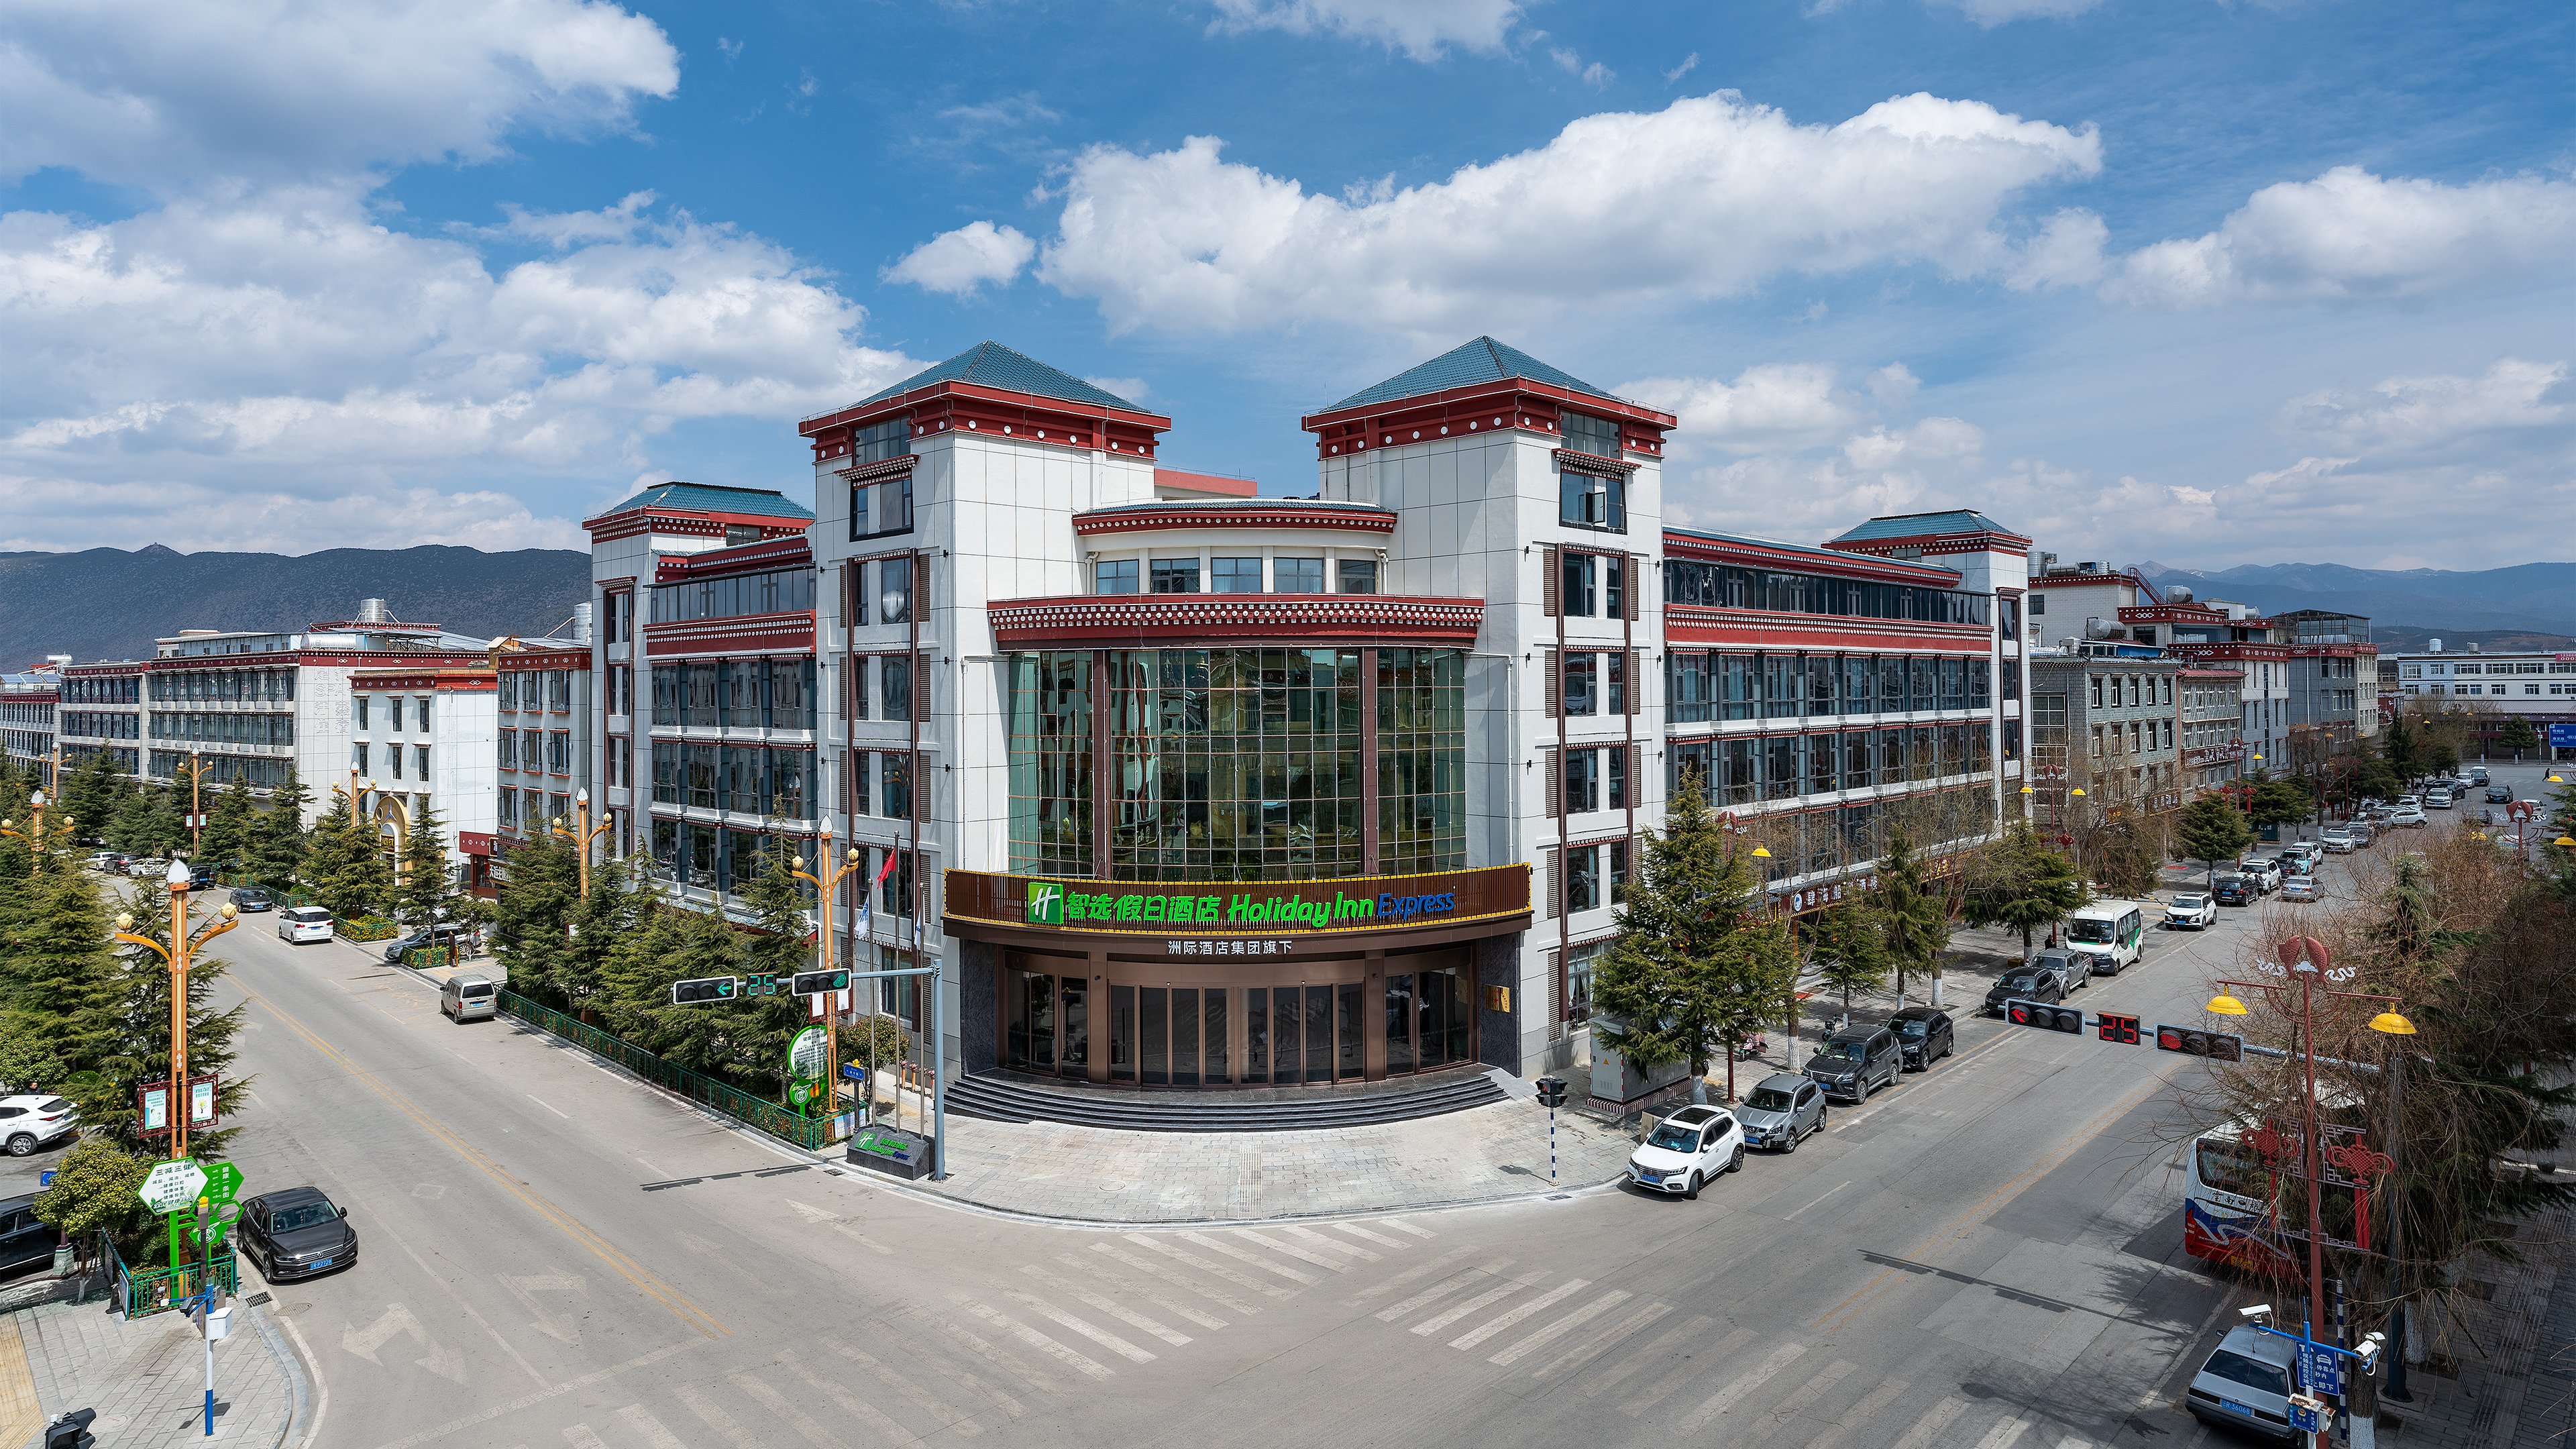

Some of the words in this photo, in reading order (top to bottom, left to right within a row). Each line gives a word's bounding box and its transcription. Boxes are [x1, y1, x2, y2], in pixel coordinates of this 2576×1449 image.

[315, 683, 347, 698] SPA
[1067, 891, 1222, 922] 智选假日酒店
[1227, 893, 1331, 927] Holiday
[1334, 890, 1375, 920] Inn
[1376, 891, 1455, 920] Express
[1167, 940, 1293, 955] 洲际酒店集团旗下
[747, 974, 777, 996] 25
[2100, 1014, 2138, 1044] 25
[155, 1162, 197, 1177] 三减三健
[222, 1166, 230, 1199] 健康一条街
